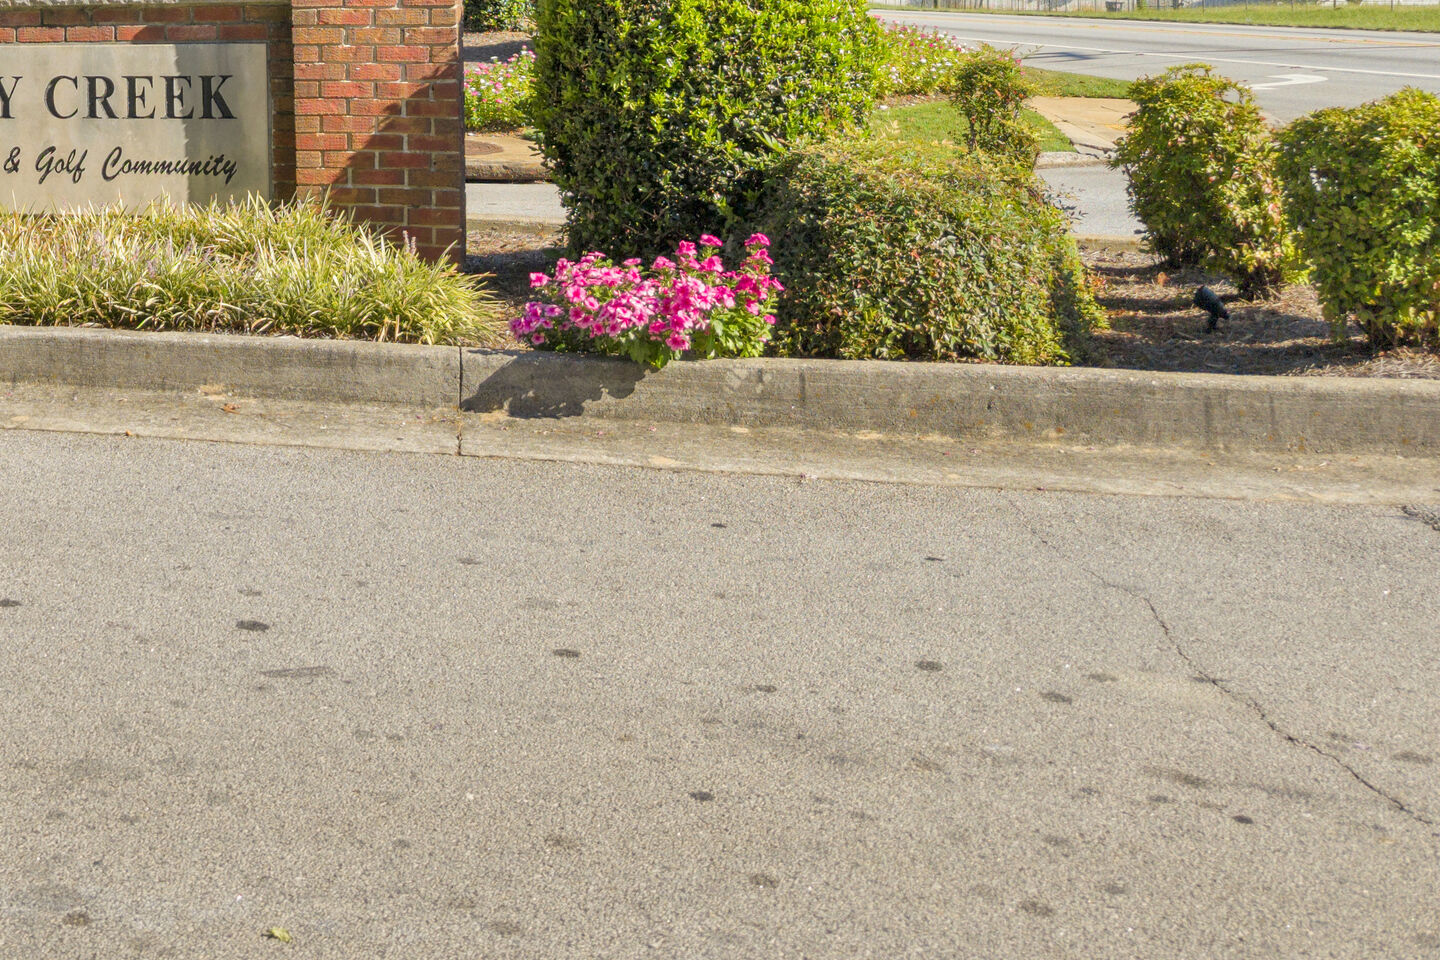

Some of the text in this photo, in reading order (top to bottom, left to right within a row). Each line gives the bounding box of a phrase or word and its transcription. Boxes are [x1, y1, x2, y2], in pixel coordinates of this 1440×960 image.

[43, 74, 237, 120] CREEK
[3, 146, 21, 173] &
[35, 146, 88, 184] Golf
[101, 145, 237, 185] Community
